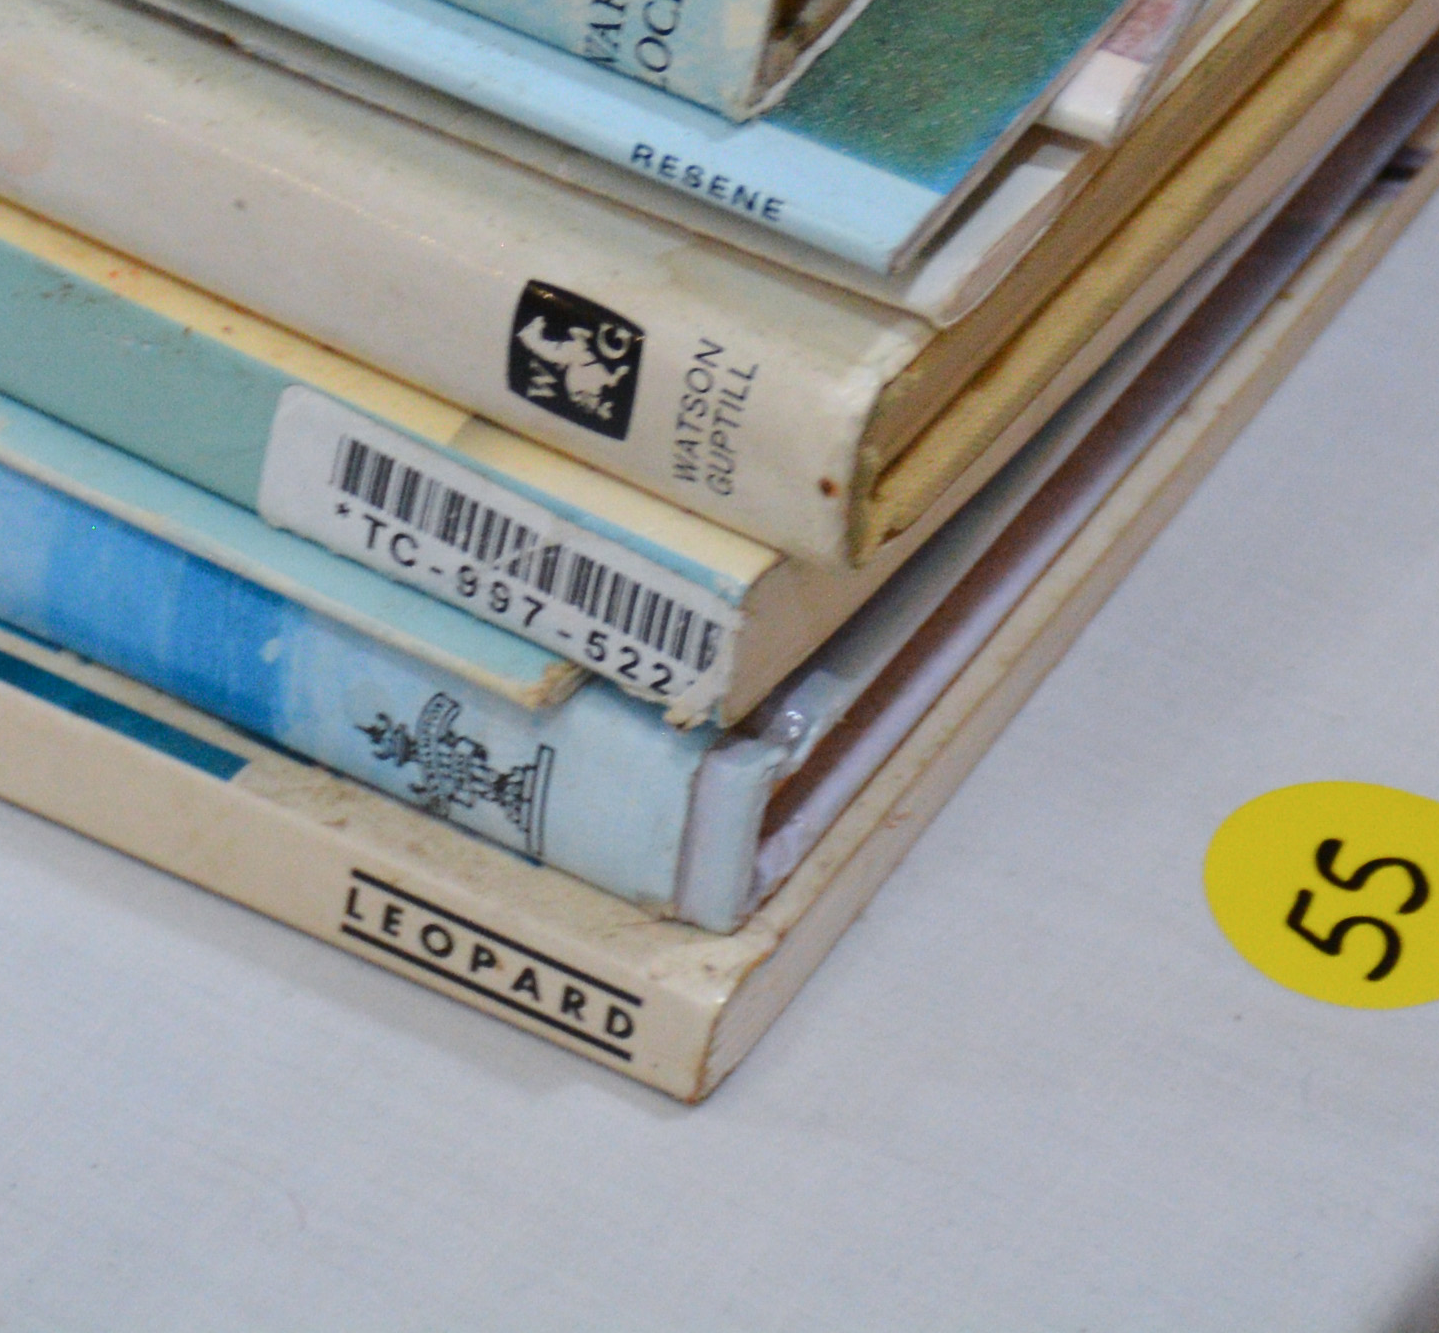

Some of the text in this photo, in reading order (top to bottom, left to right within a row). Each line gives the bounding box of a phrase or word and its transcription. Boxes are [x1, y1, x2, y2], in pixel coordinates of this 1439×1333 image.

[630, 144, 787, 222] RESENE
[673, 339, 724, 483] WATSON
[704, 362, 759, 497] GUPTILL
[345, 886, 634, 1040] LEOPARD
